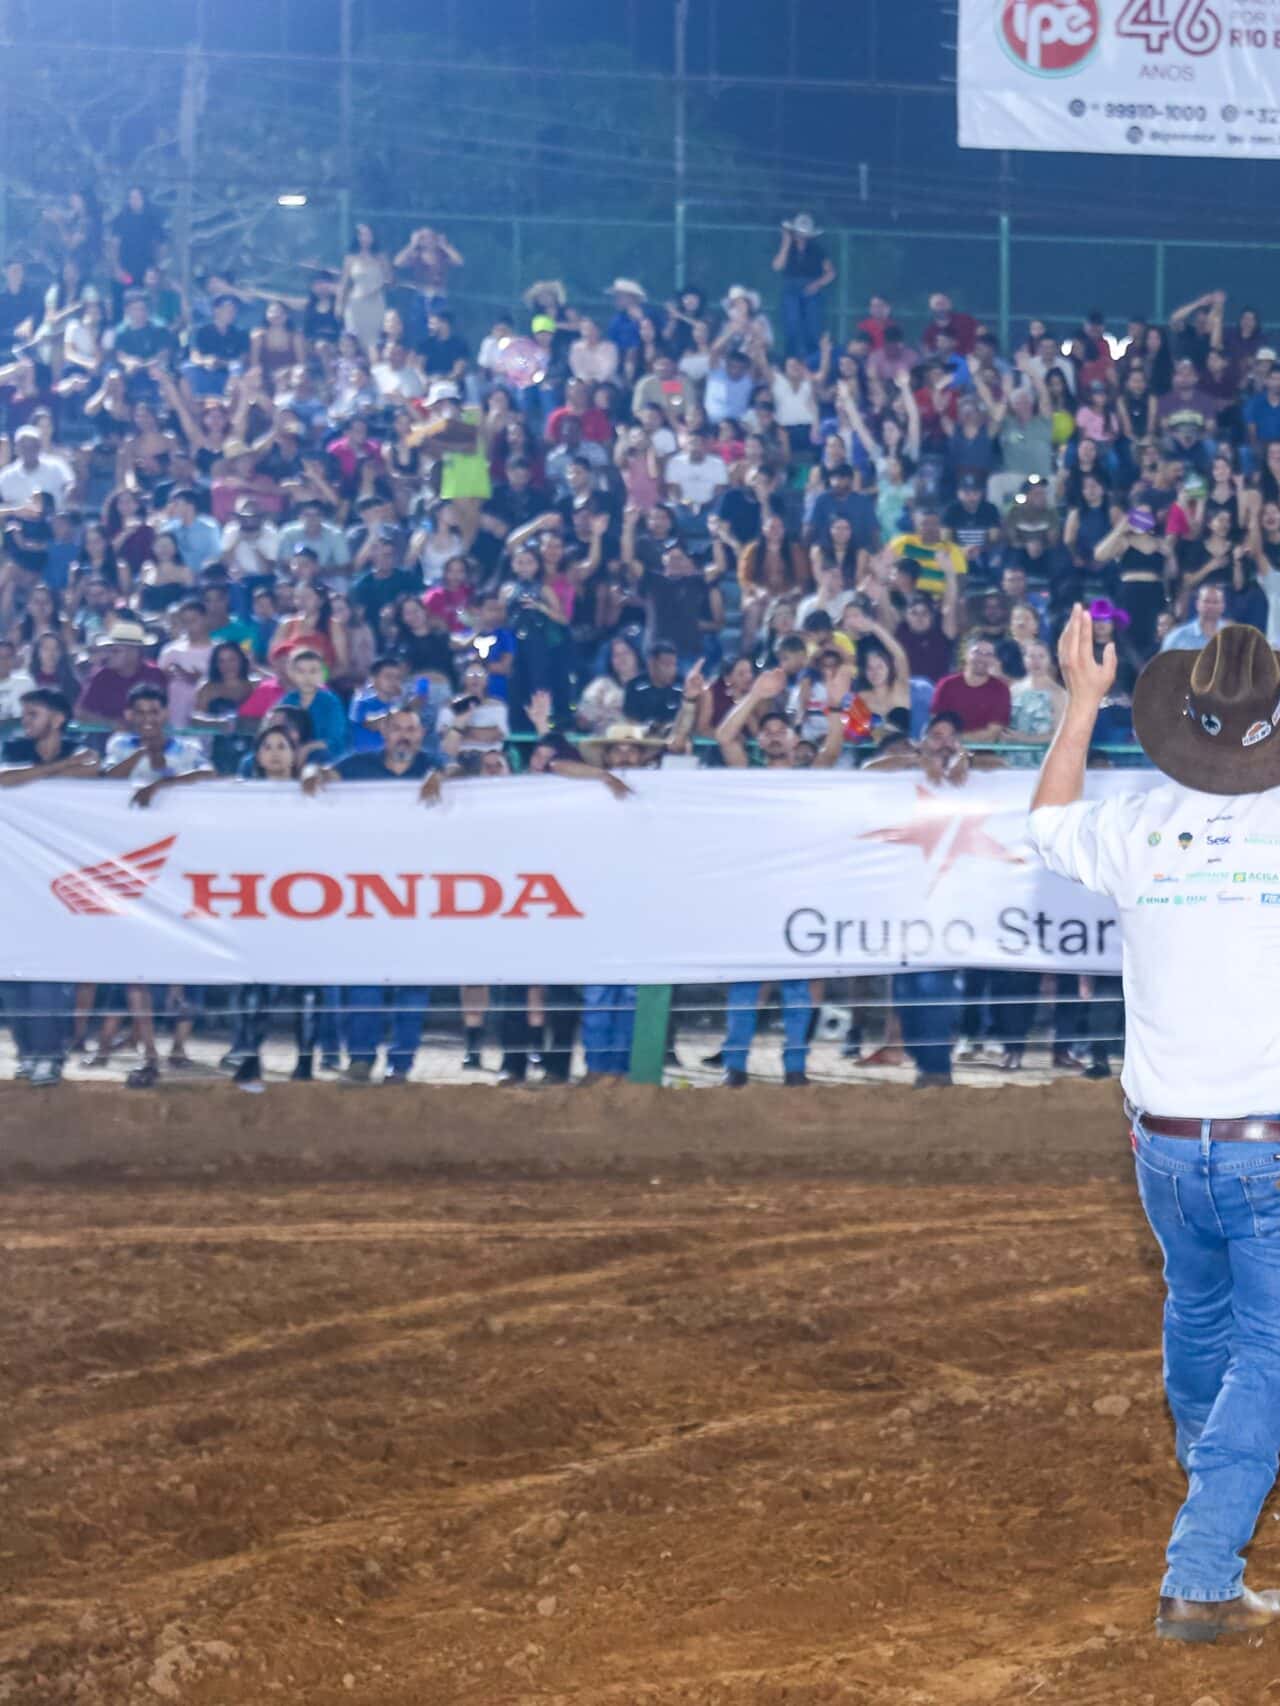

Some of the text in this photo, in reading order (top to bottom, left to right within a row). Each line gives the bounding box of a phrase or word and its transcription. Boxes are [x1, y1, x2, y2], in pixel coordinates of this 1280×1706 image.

[1116, 0, 1222, 56] 46
[1229, 29, 1266, 49] RIO
[1138, 64, 1195, 82] ANOS
[182, 872, 585, 920] HONDA
[784, 907, 1116, 966] Grupo Star
